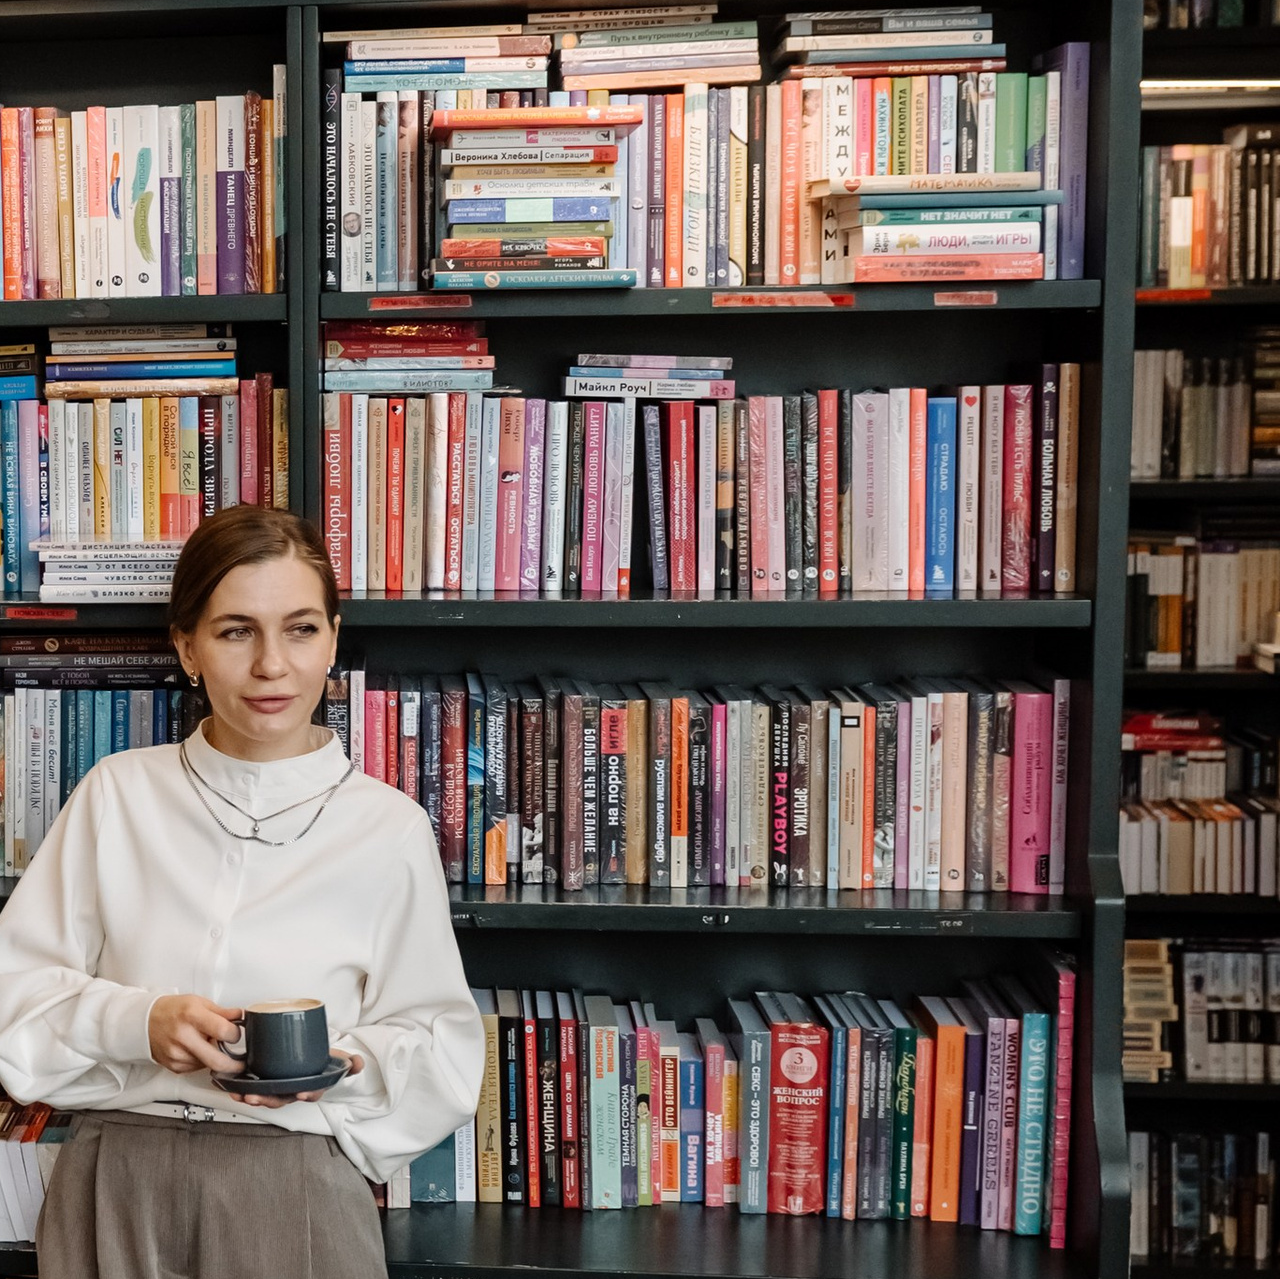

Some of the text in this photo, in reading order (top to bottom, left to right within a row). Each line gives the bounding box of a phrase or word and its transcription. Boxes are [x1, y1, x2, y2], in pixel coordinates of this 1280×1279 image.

[57, 126, 66, 152] СЕБЕ
[455, 150, 590, 162] Вероника Хлебова Сепарация
[58, 165, 68, 202] ЗАБОТА
[910, 178, 993, 190] МАТЕМАТИКА
[921, 210, 1012, 221] НЕТ ЗНАЧИТ НЕТ
[928, 233, 1032, 248] ЛЮДИ, ИГРЫ
[5, 441, 16, 564] НЕ ВСЯКАЯ ВИНА ВИНОВАТА
[203, 408, 217, 517] ПРИРОДА ЗВЕРЯ
[587, 408, 599, 541] ПОЧЕМУ ЛЮБОВЬ РАНИТ?
[1041, 438, 1055, 532] БОЛЬНАЯ ЛЮБОВЬ
[328, 432, 347, 584] Метафоры любви
[48, 699, 59, 784] Меня всё бесит!
[773, 712, 789, 767] ПОСЛЕДНЯЯ ДЕВУШКА
[797, 722, 809, 764] Лу Саломе
[583, 728, 596, 852] БОЛЬШЕ ЧЕМ ЖЕЛАНИЕ
[655, 759, 667, 862] рустам александер
[774, 771, 788, 854] PLAYBOY
[793, 787, 808, 836] ЭРОТИКА
[542, 1080, 554, 1152] ЖЕНЩИНА
[750, 1066, 761, 1167] СЕКС ЭТО ЗДОРОВО!
[773, 1086, 823, 1105] ЖЕНСКИЙ ВОПРОС
[985, 1030, 1002, 1190] FANZINE GRRRLS
[1004, 1032, 1019, 1128] WOMEN'S CLUB
[686, 1135, 699, 1187] Вагина
[1022, 1038, 1047, 1214] ЭТО НЕ СТЫДНО
